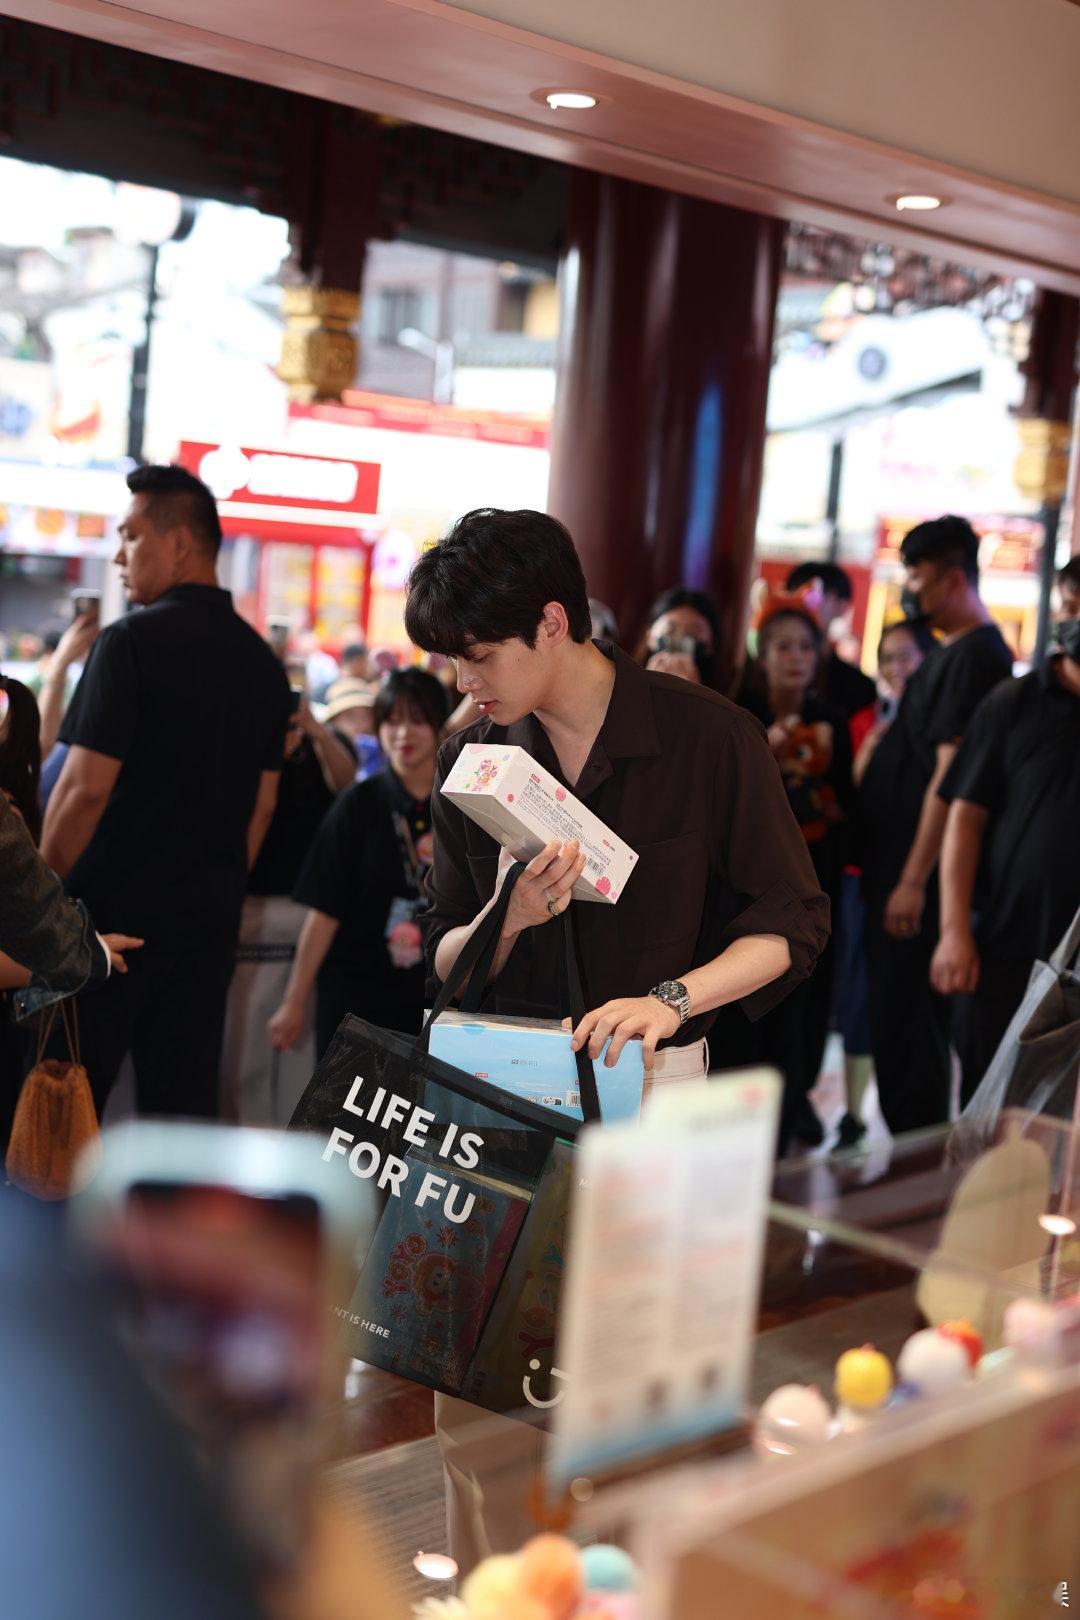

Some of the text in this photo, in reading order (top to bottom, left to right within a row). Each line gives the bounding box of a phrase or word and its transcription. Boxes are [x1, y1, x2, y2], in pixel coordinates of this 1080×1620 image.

[342, 1075, 485, 1169] LIFE IS
[321, 1126, 409, 1198] FOR
[349, 1314, 360, 1325] IS
[360, 1319, 391, 1339] HERE
